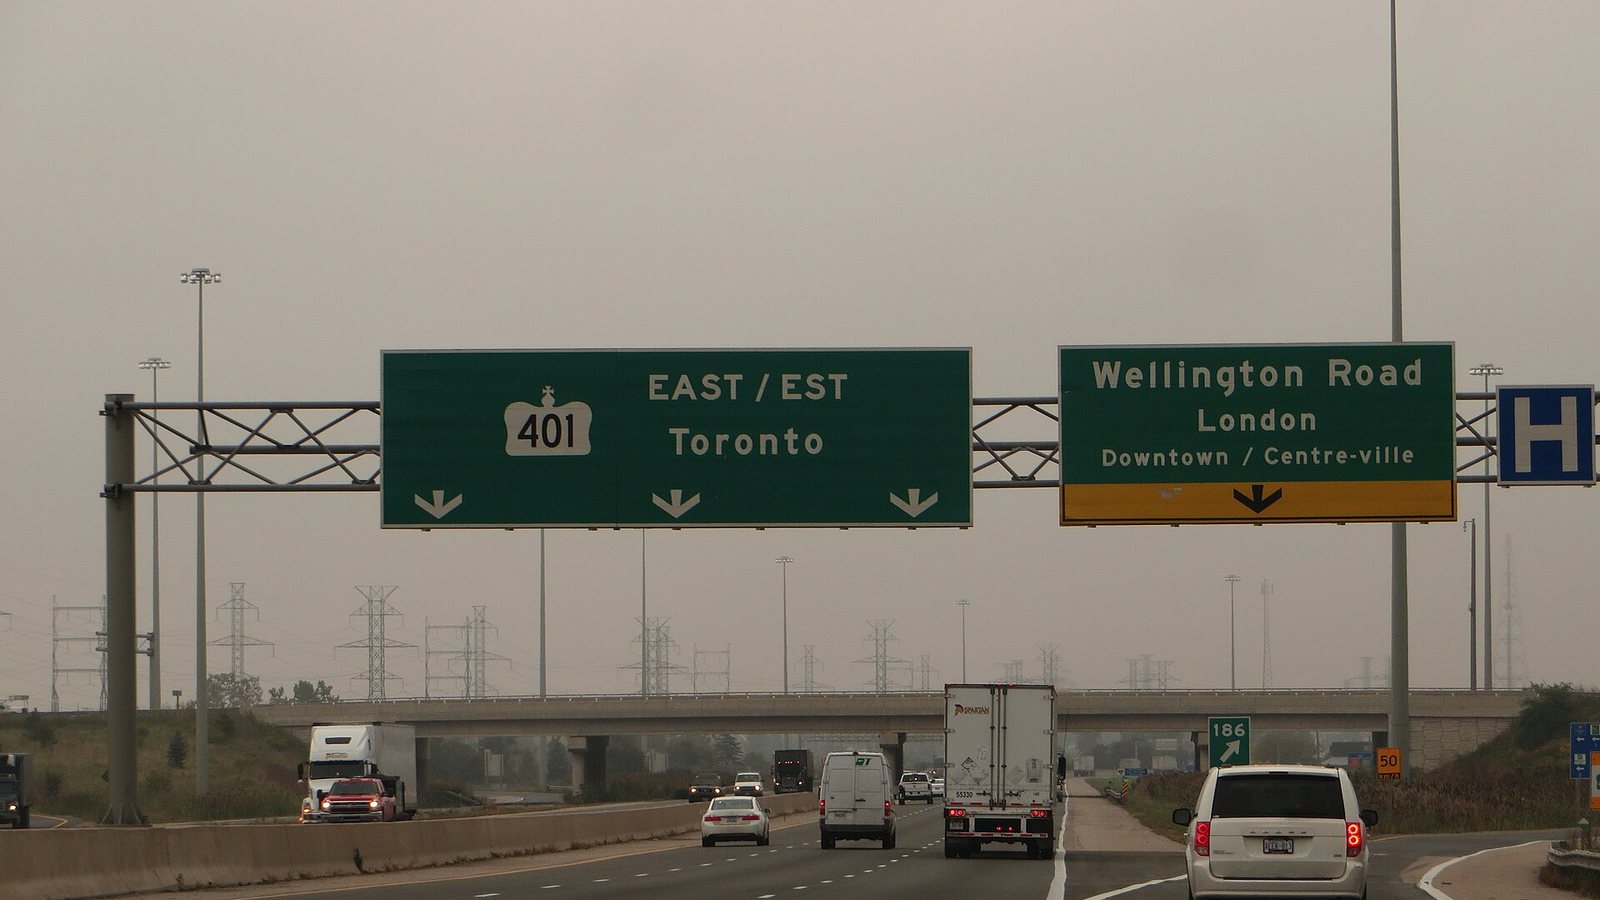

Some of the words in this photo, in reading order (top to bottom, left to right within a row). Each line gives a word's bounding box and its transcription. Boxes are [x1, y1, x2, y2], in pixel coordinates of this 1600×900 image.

[648, 374, 743, 401] EAST
[755, 374, 770, 402] /
[781, 373, 848, 401] EST
[1093, 360, 1303, 397] Wellington
[1328, 358, 1422, 387] Road
[517, 413, 574, 449] 401
[1198, 408, 1317, 432] London
[669, 427, 824, 456] Toronto
[1514, 396, 1578, 473] H
[1102, 448, 1229, 467] Downtown
[1242, 447, 1253, 465] /
[1264, 446, 1415, 466] Centre-ville
[963, 706, 990, 715] SPARTAN
[1213, 723, 1246, 737] 186
[1380, 755, 1398, 767] 50
